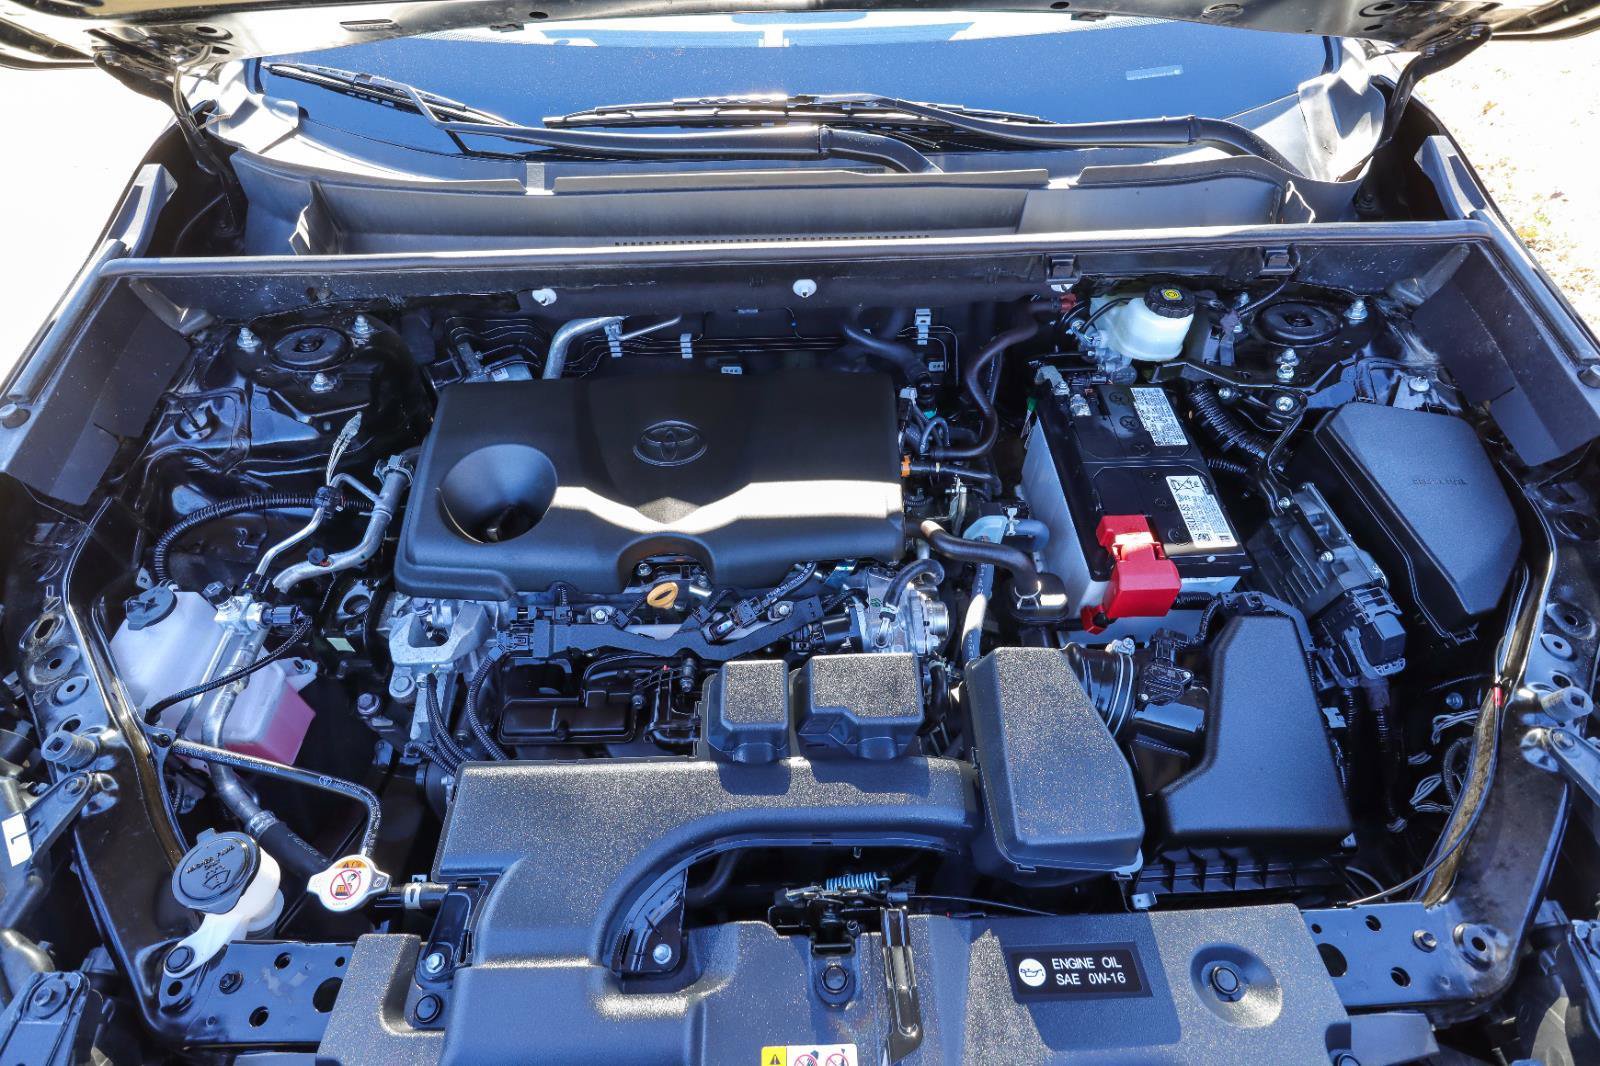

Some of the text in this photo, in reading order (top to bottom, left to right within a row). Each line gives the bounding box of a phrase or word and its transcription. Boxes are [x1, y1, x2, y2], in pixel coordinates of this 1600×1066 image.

[1051, 956, 1122, 970] ENGINE OIL
[1055, 972, 1126, 986] SAE 0W-16
